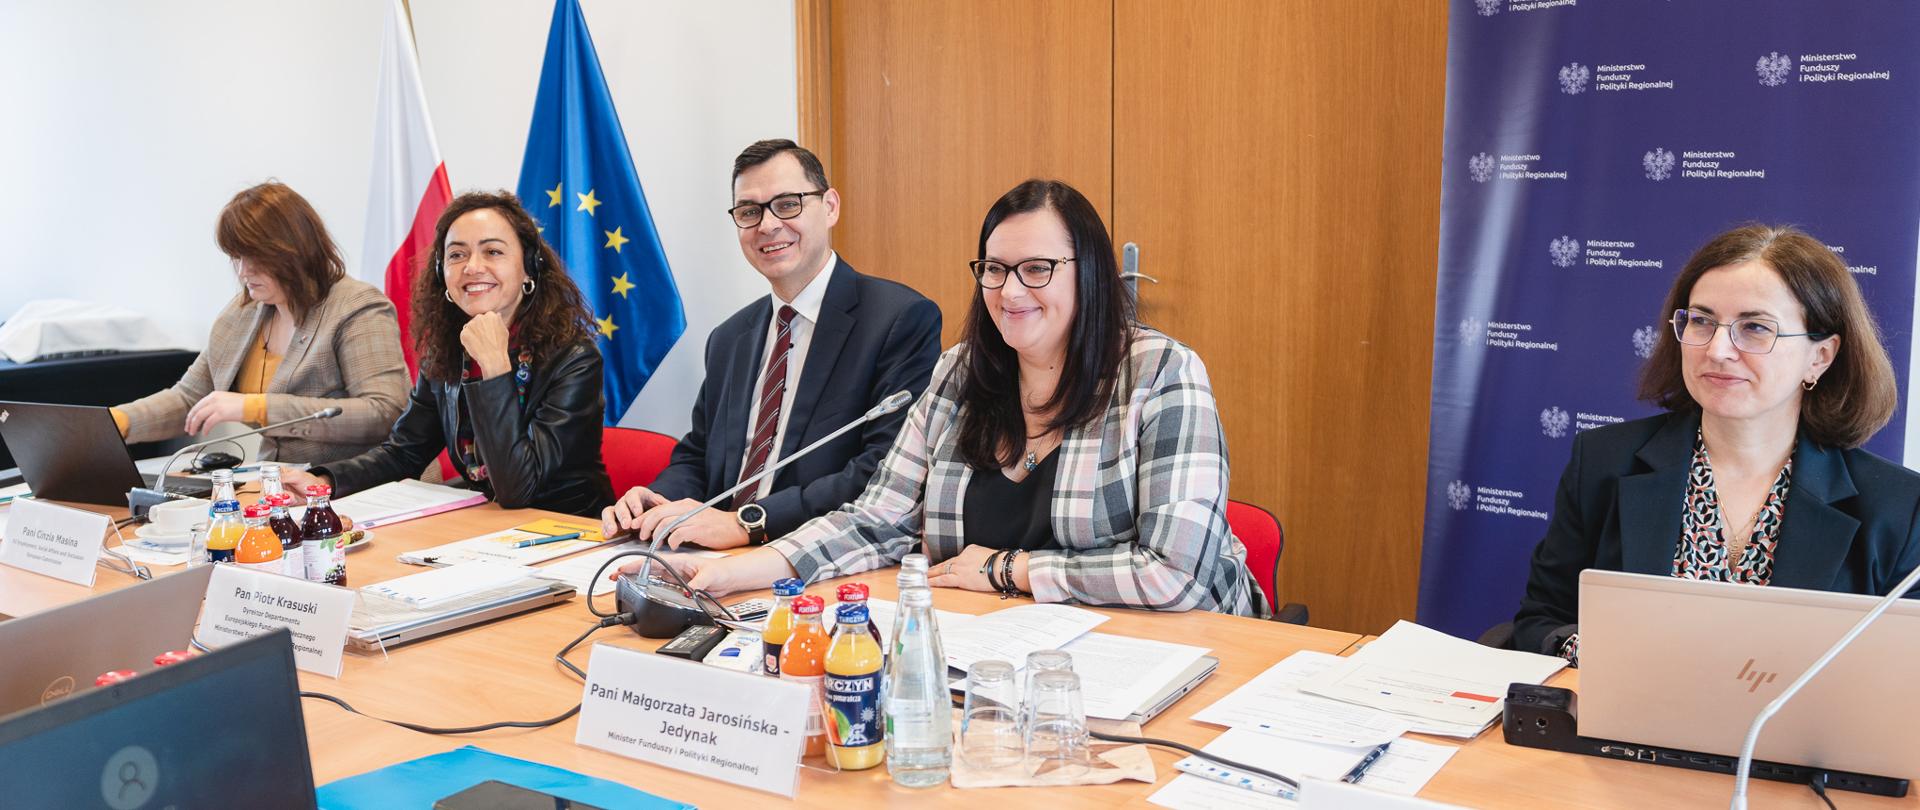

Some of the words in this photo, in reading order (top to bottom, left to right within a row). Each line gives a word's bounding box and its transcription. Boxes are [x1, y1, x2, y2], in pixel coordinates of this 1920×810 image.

[1512, 2, 1537, 11] Polityki
[1800, 52, 1857, 62] Ministerstwo
[1597, 63, 1645, 73] Ministerstwo
[1799, 64, 1840, 73] Funduszy
[1596, 73, 1631, 82] Funduszy
[1803, 73, 1836, 82] Polityki
[1837, 70, 1890, 81] Regionalnej
[1599, 82, 1627, 91] Polityki
[1628, 80, 1673, 90] Regionalnej
[1500, 154, 1541, 162] Ministerstwo
[1683, 150, 1735, 159] Ministerstwo
[1499, 163, 1528, 171] Funduszy
[1682, 160, 1720, 169] Funduszy
[1502, 171, 1524, 180] Polityki
[1525, 170, 1567, 180] Regionalnej
[1685, 169, 1716, 179] Polityki
[1717, 169, 1765, 179] Regionalnej
[1586, 239, 1635, 249] Ministerstwo
[1586, 249, 1620, 257] Funduszy
[1588, 257, 1617, 267] Polityki
[1617, 259, 1663, 268] Regionalnej
[1487, 321, 1532, 331] Ministerstwo
[1487, 330, 1518, 340] Funduszy
[1489, 339, 1514, 348] Polityki
[1515, 340, 1558, 351] Regionalnej
[1576, 412, 1624, 424] Ministerstwo
[1477, 486, 1523, 498] Ministerstwo
[1476, 496, 1510, 506] Funduszy
[1479, 504, 1506, 515] Polityki
[1507, 507, 1548, 520] Regionalnej
[22, 526, 36, 536] Pani
[36, 530, 55, 541] Cinzia
[55, 535, 79, 547] Masina
[234, 586, 251, 601] Pan
[253, 591, 275, 606] Piotr
[276, 595, 318, 615] Krasuski
[242, 606, 264, 618] Dyrektor
[589, 682, 618, 702] Pani
[621, 688, 696, 718] Małgorzata
[699, 705, 778, 737] Jarosińska
[659, 720, 718, 746] Jedynak
[607, 730, 637, 745] Minister
[638, 737, 673, 755] Funduszy
[679, 748, 709, 764] Polityki
[710, 754, 759, 776] Regionalnej
